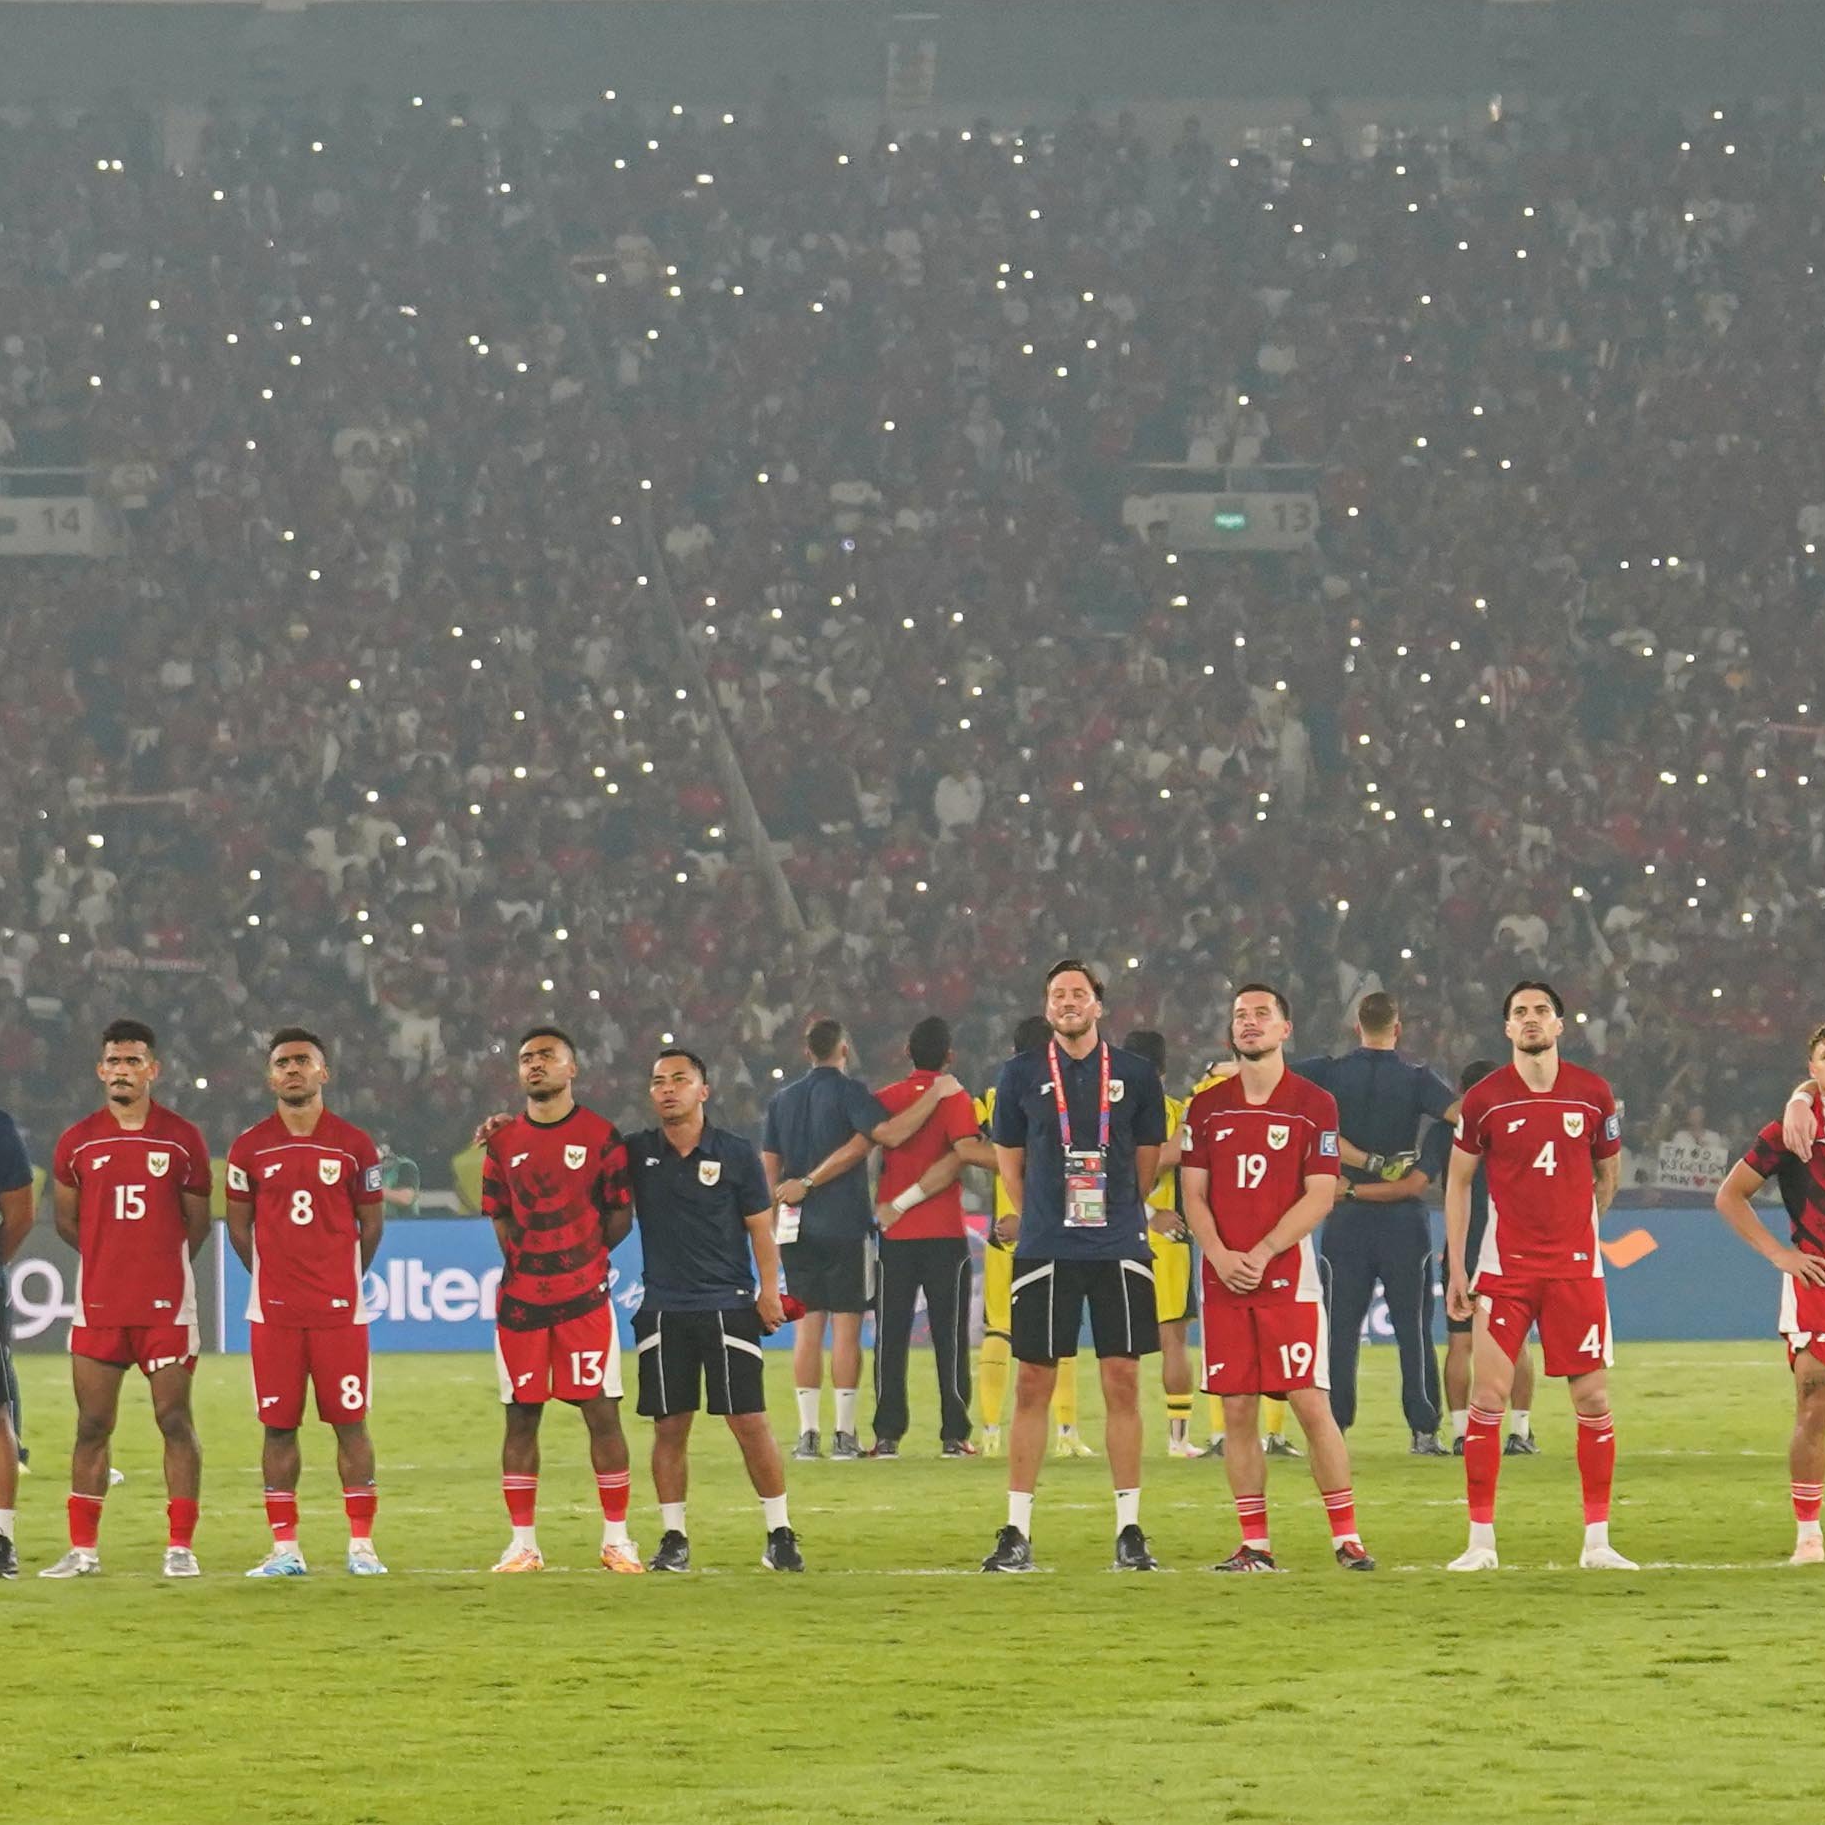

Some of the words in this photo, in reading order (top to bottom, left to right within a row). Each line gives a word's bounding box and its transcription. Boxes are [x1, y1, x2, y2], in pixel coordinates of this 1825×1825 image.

[40, 507, 81, 535] 14
[1273, 502, 1312, 532] 13
[1237, 1154, 1267, 1189] 19
[1533, 1141, 1557, 1177] 4
[115, 1184, 146, 1221] 15
[290, 1189, 314, 1226] 8
[1578, 1324, 1602, 1359] 4
[570, 1350, 604, 1386] 13
[1279, 1342, 1313, 1378] 19
[340, 1375, 364, 1410] 8
